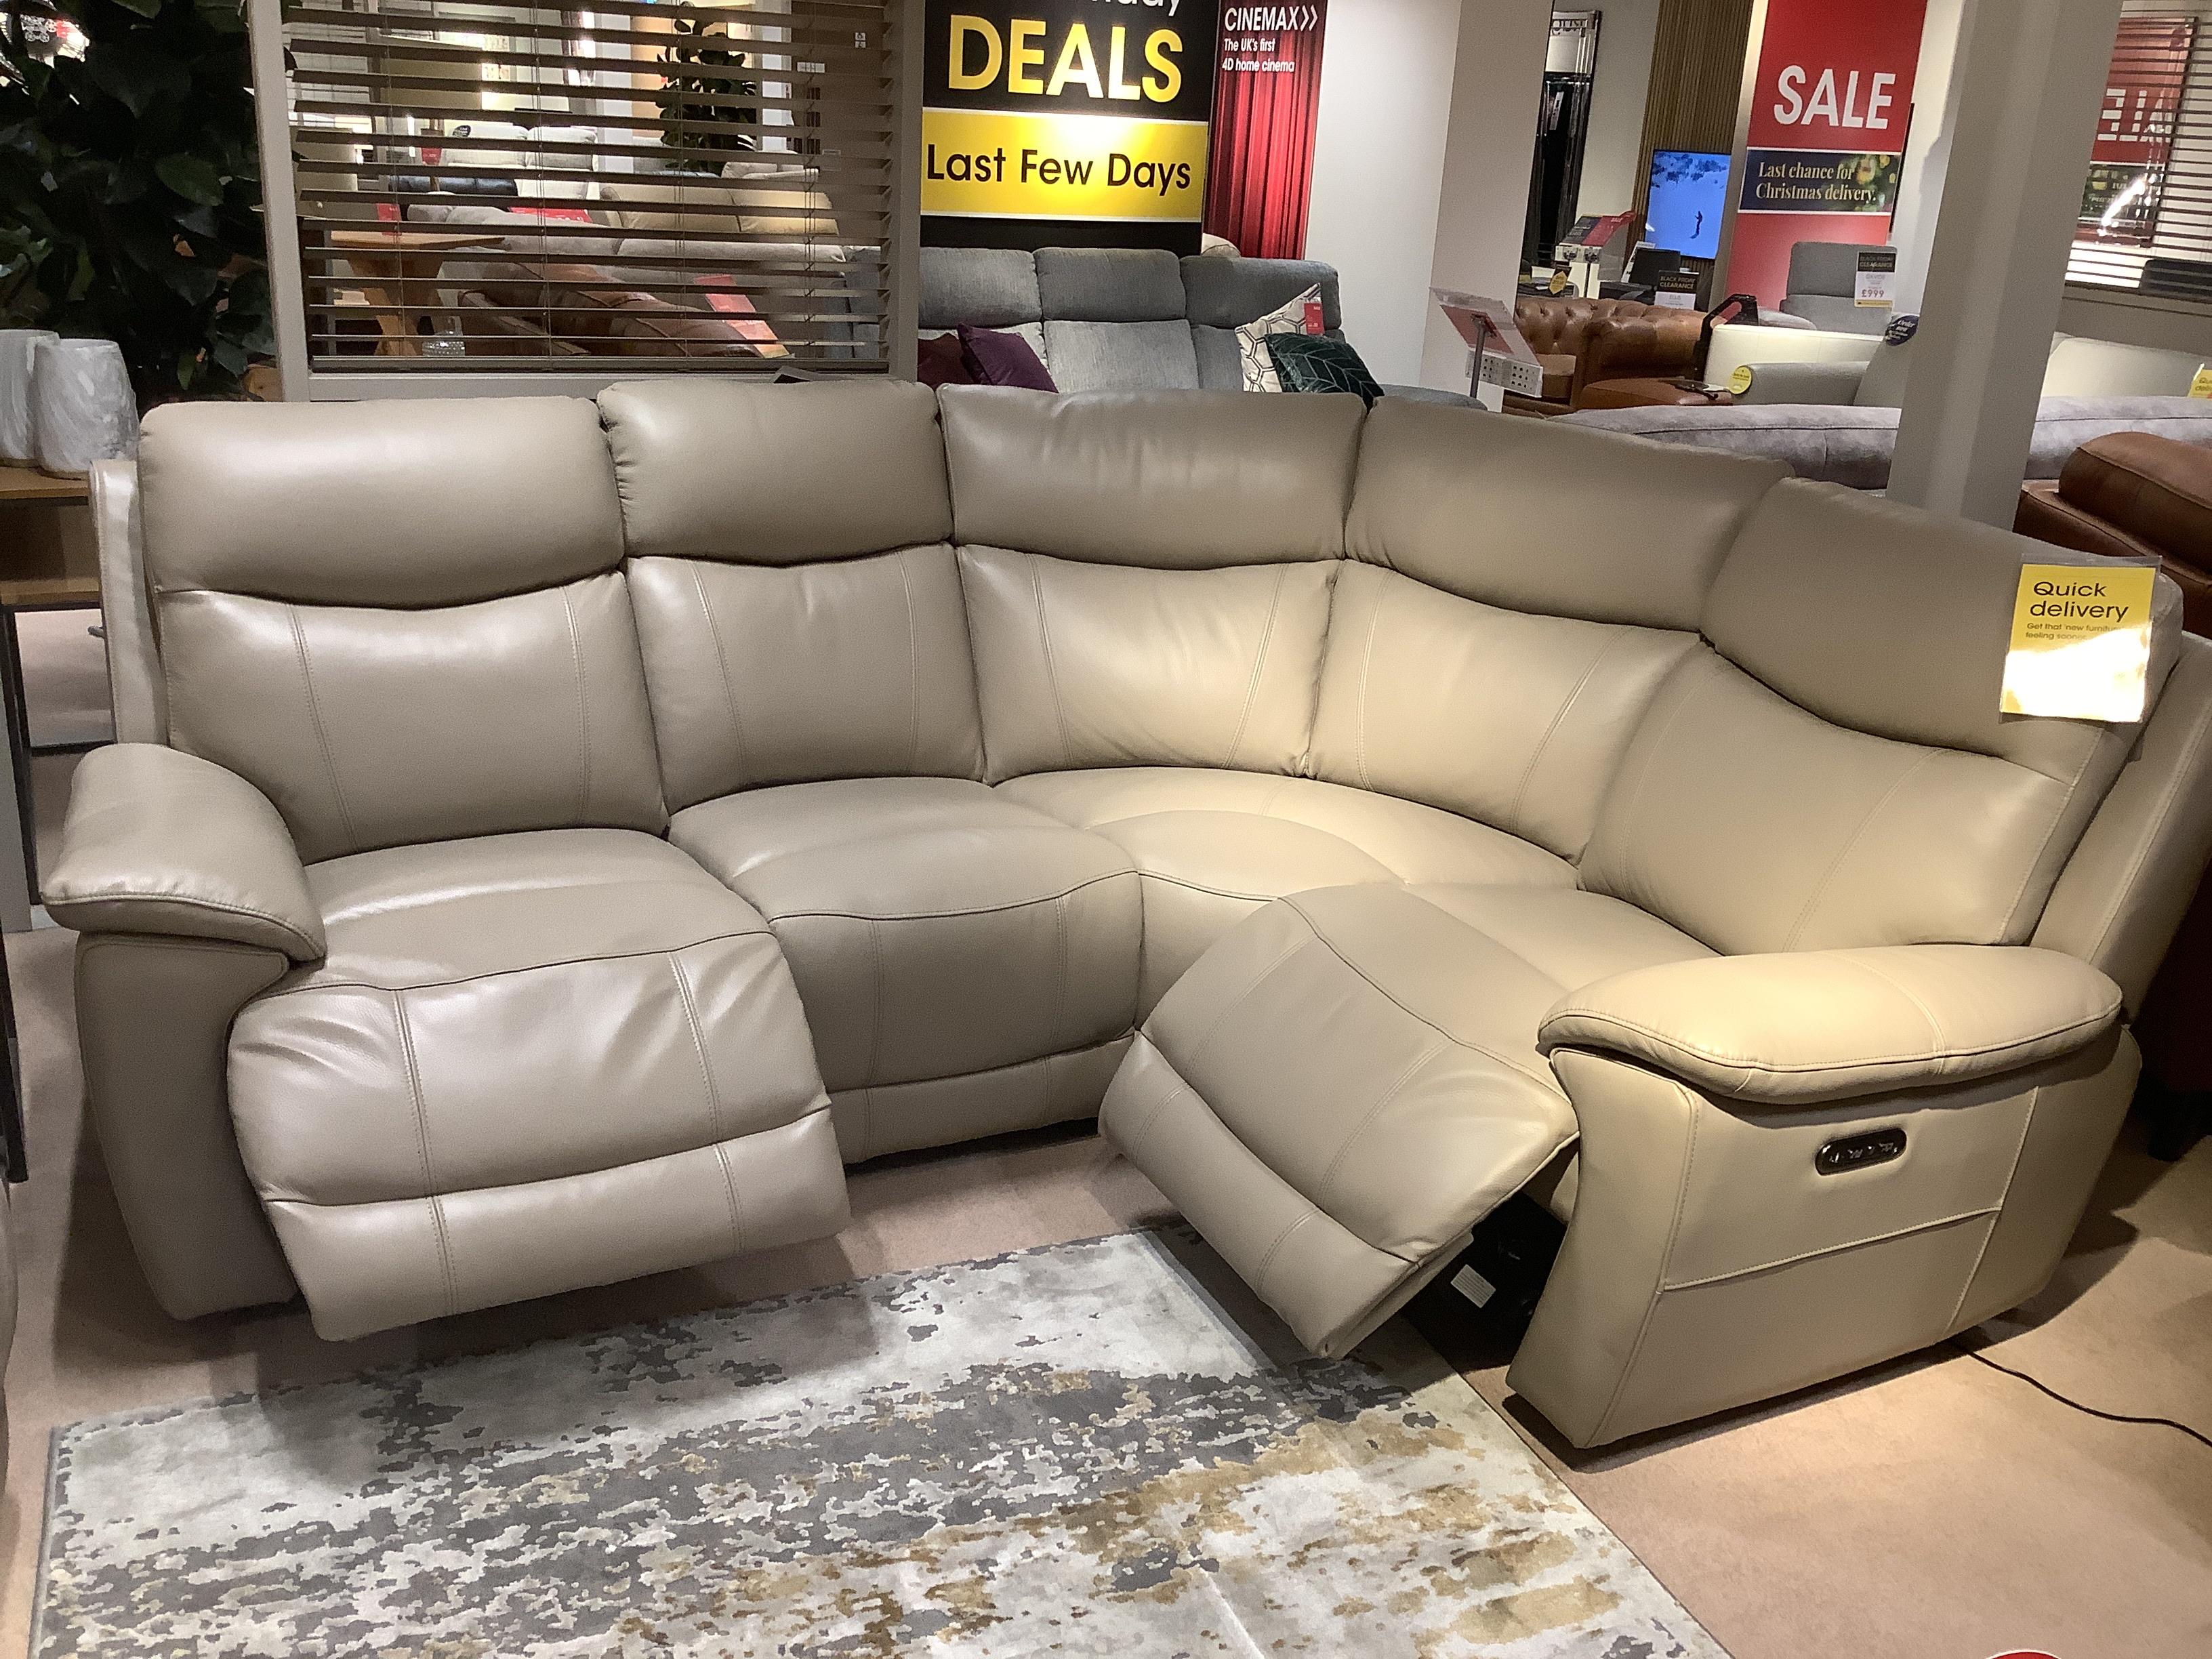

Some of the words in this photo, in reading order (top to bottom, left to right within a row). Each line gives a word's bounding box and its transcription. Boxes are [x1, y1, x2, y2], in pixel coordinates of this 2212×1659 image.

[1224, 38, 1239, 52] The
[1241, 38, 1258, 52] UK's
[1260, 38, 1275, 52] first
[949, 14, 1183, 103] DEALS
[1222, 58, 1234, 71] 4D
[1235, 58, 1260, 72] home
[1261, 58, 1295, 73] cinema
[1774, 65, 1896, 129] SALE
[927, 144, 1006, 183] Last
[1021, 148, 1094, 185] Few
[1107, 153, 1191, 197] Days
[1759, 161, 1786, 179] Last
[1788, 162, 1835, 180] chance
[1837, 163, 1856, 180] for
[1755, 183, 1822, 200] Christmas
[1824, 184, 1877, 204] delivery.
[1862, 289, 1884, 298] £999
[2034, 581, 2107, 596] Quick
[2030, 600, 2129, 623] delivery
[2026, 632, 2054, 640] feeling
